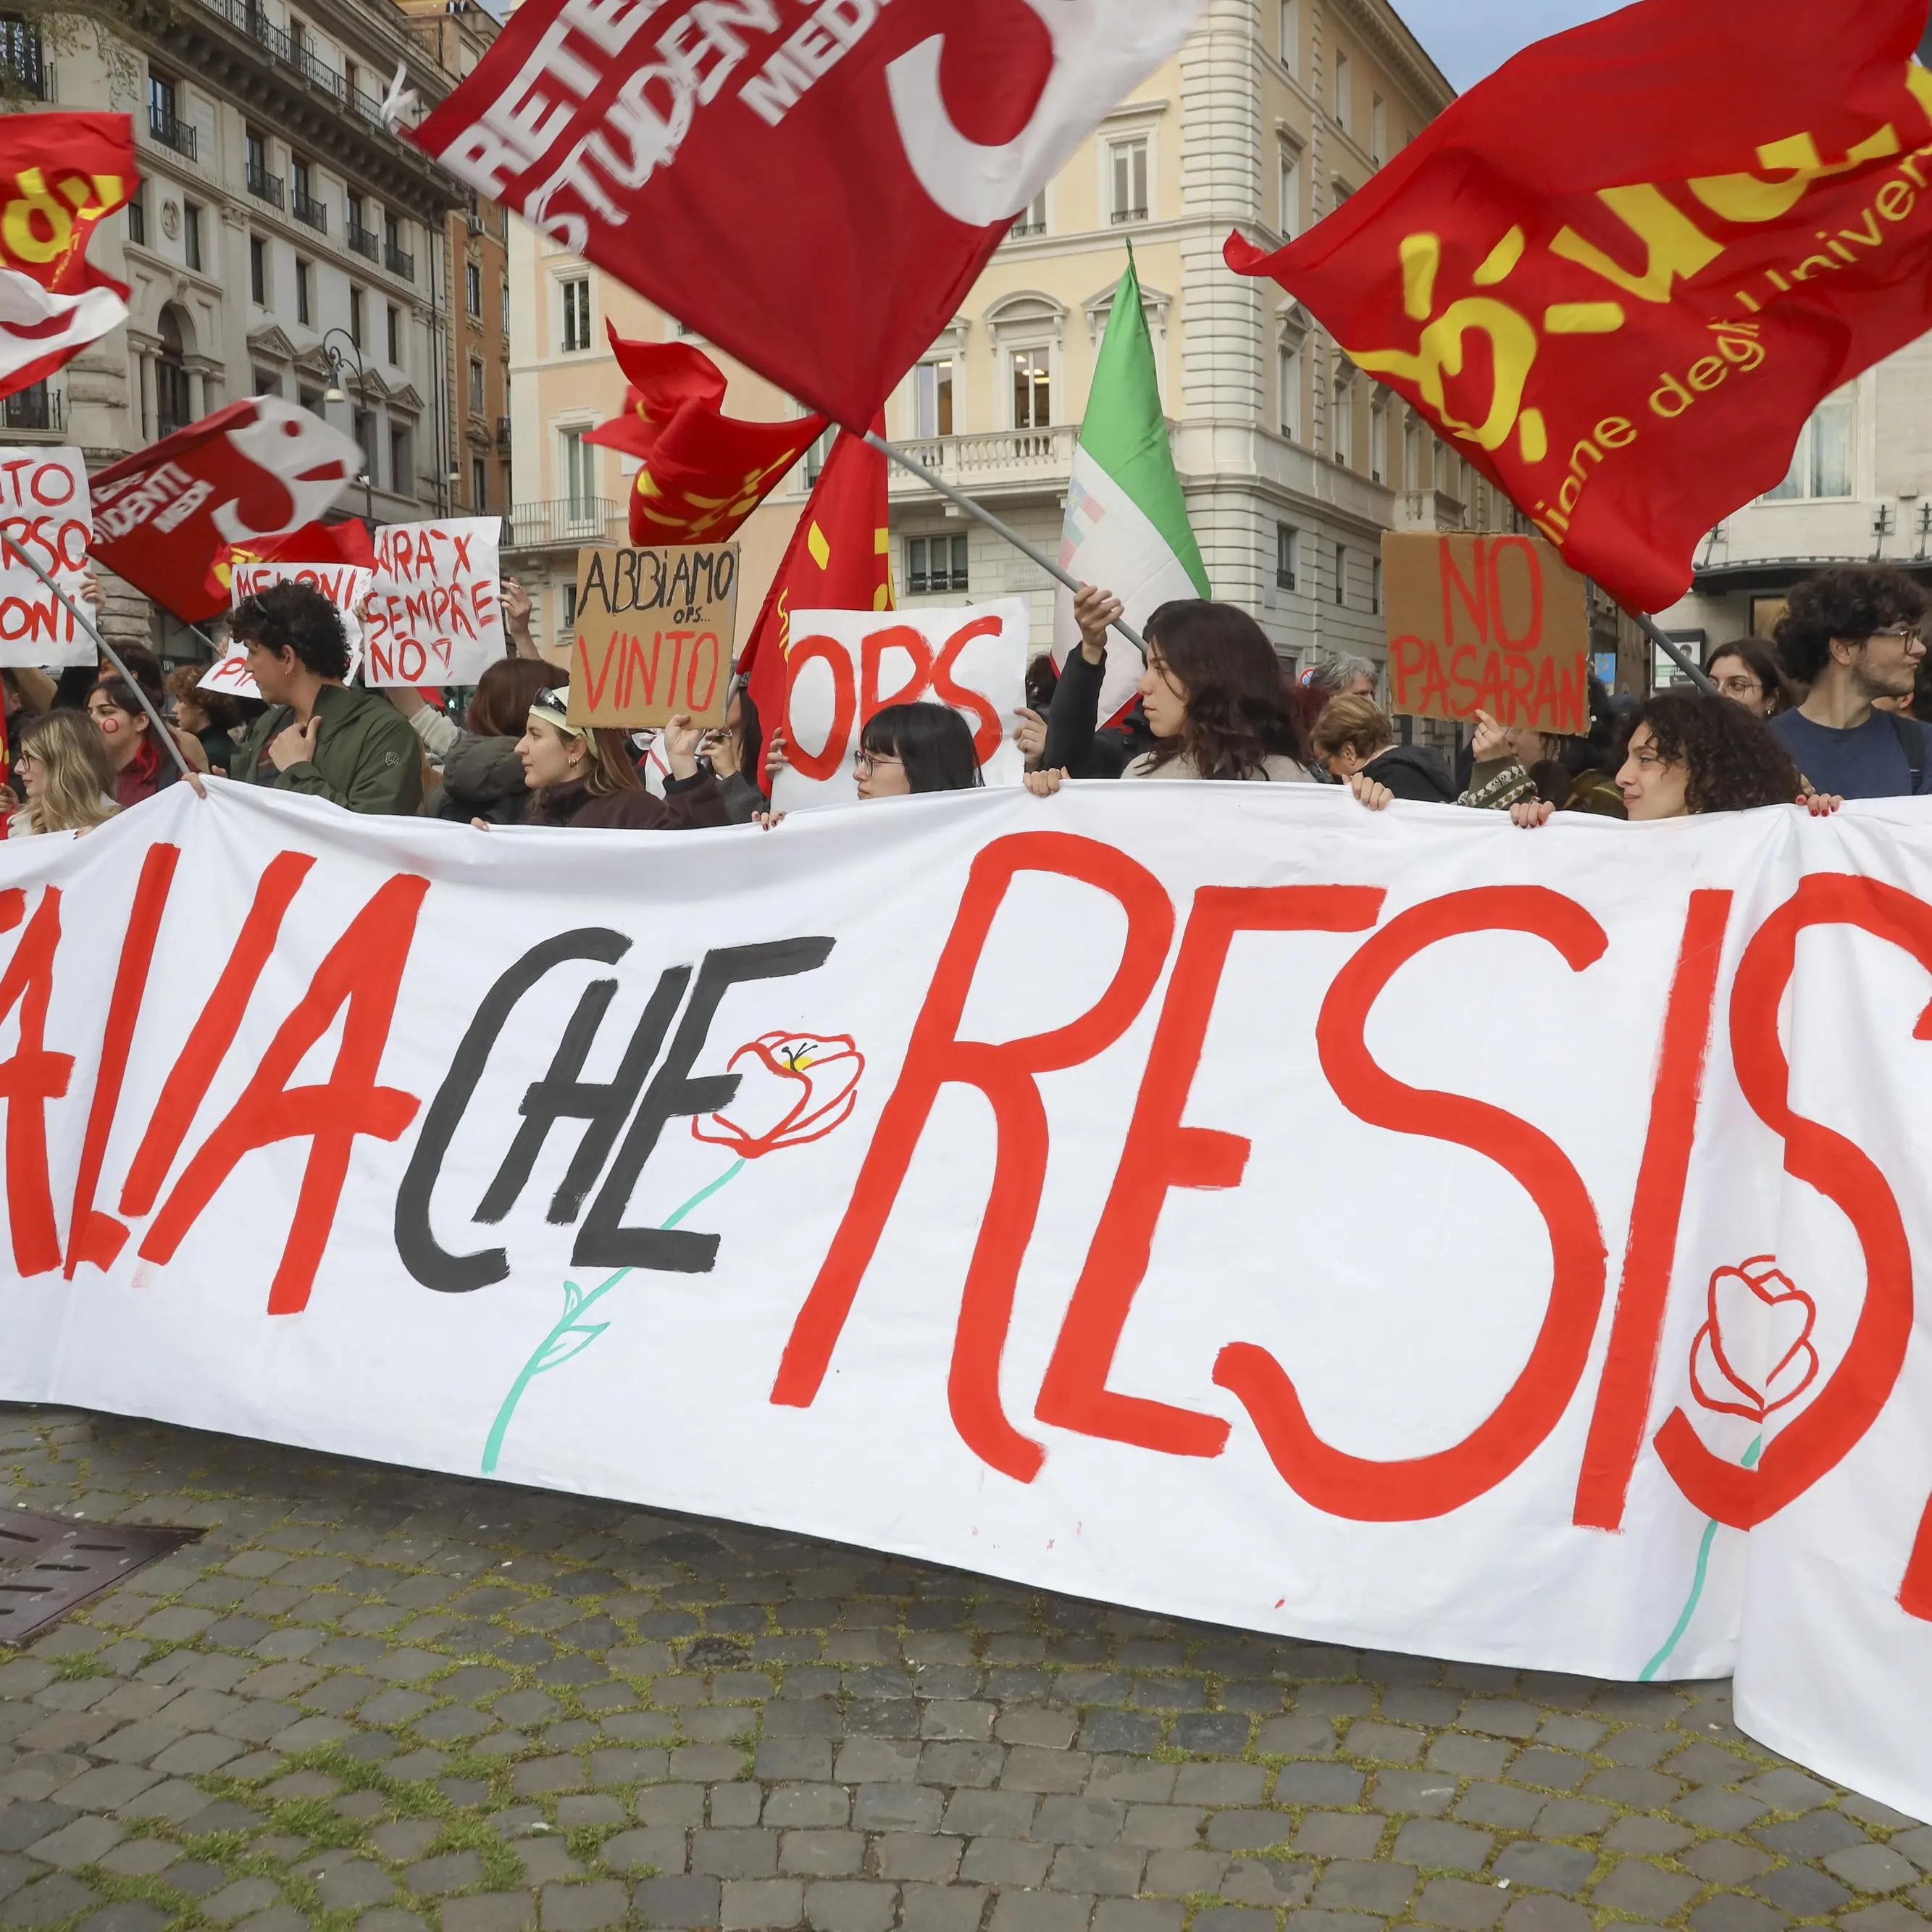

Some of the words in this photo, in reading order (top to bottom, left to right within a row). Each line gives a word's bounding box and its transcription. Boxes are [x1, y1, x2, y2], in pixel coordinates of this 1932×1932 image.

[436, 0, 666, 201] RETE
[0, 459, 75, 507] TO
[364, 580, 498, 642] SEMPRE
[1439, 535, 1543, 651] NO
[578, 630, 719, 714] VINTO
[787, 616, 1004, 782] OPS
[1390, 635, 1586, 732] PASARAN
[0, 843, 431, 1316] ALIA
[394, 927, 837, 1293] CHE
[769, 829, 1932, 1623] RESIS
